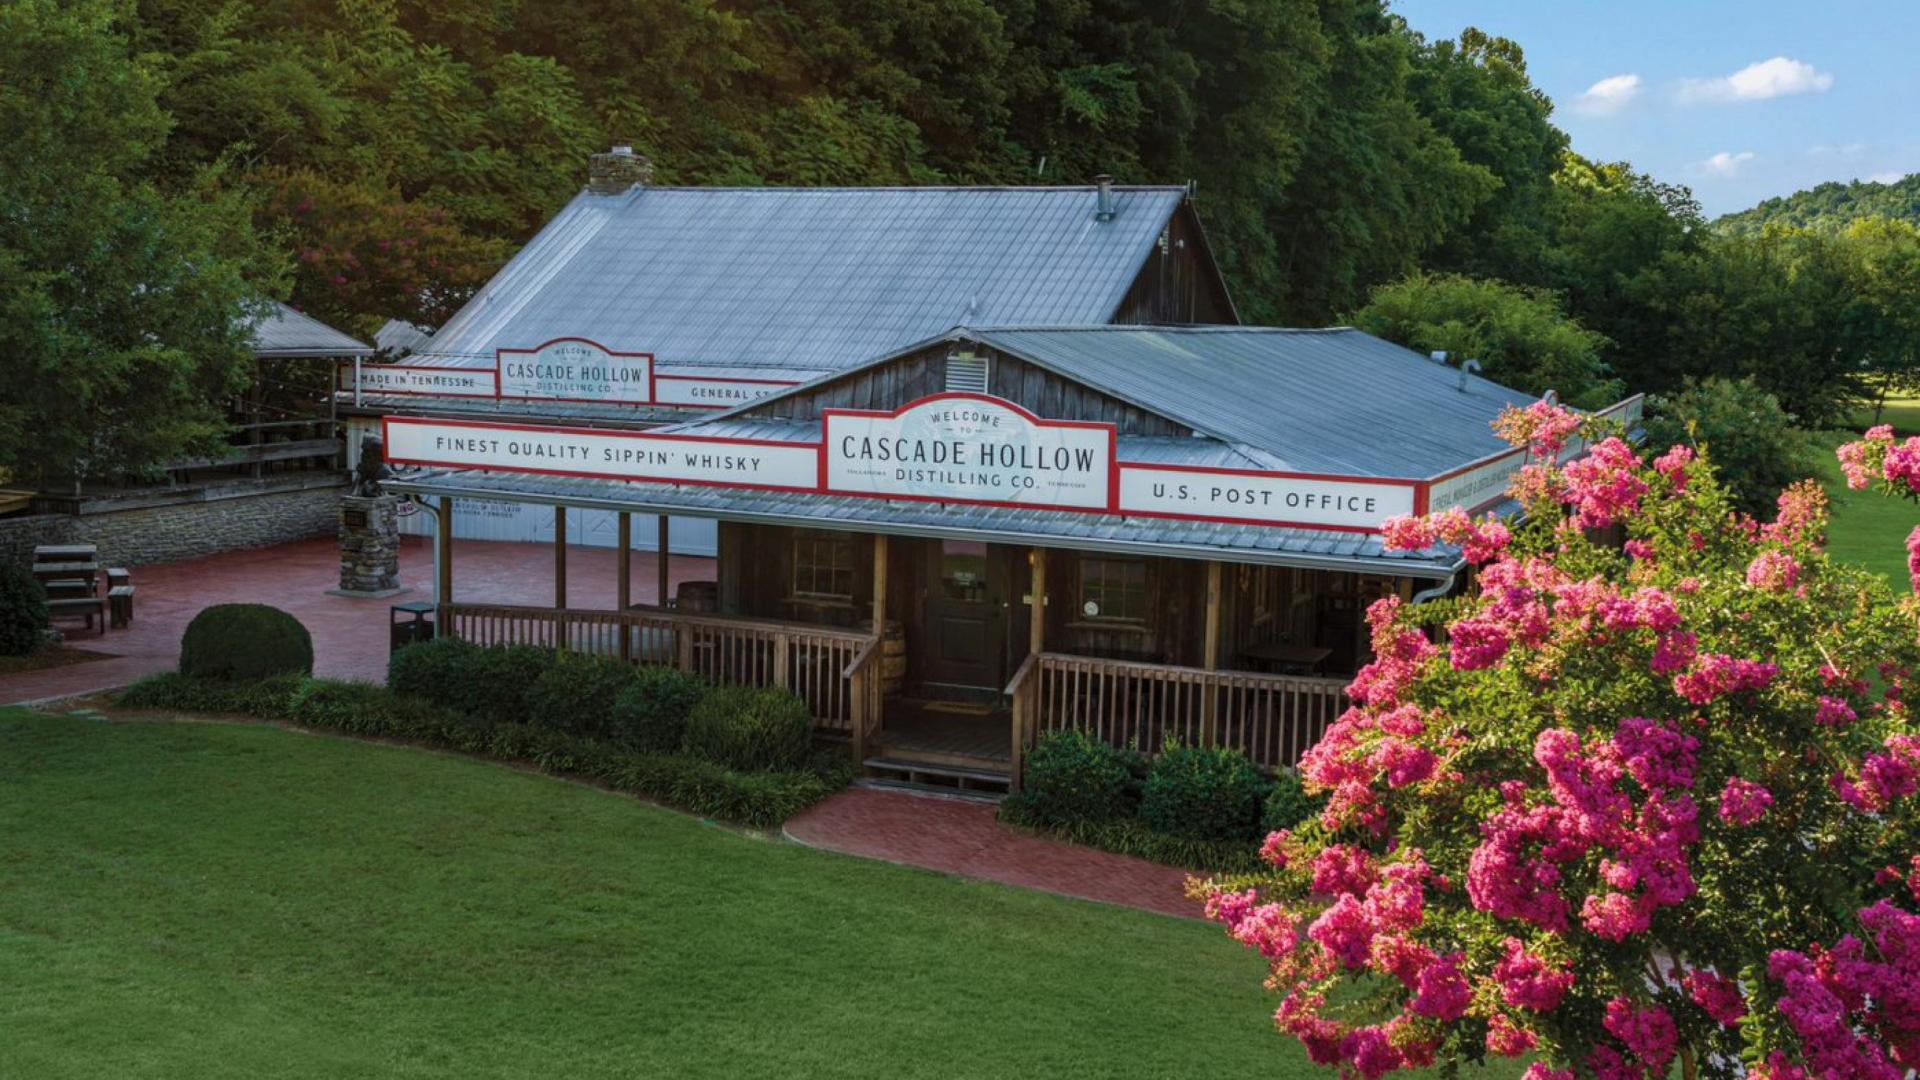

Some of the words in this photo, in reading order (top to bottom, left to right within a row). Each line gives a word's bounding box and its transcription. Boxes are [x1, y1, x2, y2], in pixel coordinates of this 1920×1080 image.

[360, 374, 390, 384] MADE
[395, 376, 407, 384] IN
[507, 363, 575, 380] CASCADE
[581, 367, 642, 383] HOLLOW
[536, 382, 593, 393] DISTILLING
[691, 387, 749, 400] GENERAL
[931, 411, 1000, 428] WELCOME
[960, 426, 972, 434] TO
[436, 436, 499, 454] FINEST
[508, 441, 590, 460] QUALITY
[603, 448, 675, 465] SIPPIN'
[685, 453, 761, 472] WHISKY
[842, 435, 966, 466] CASCADE
[980, 443, 1094, 473] HOLLOW
[896, 468, 1001, 487] DISTILLING
[1011, 475, 1040, 489] CO.
[1153, 483, 1198, 500] U.S.
[1211, 487, 1273, 506] POST
[1286, 492, 1376, 513] OFFICE
